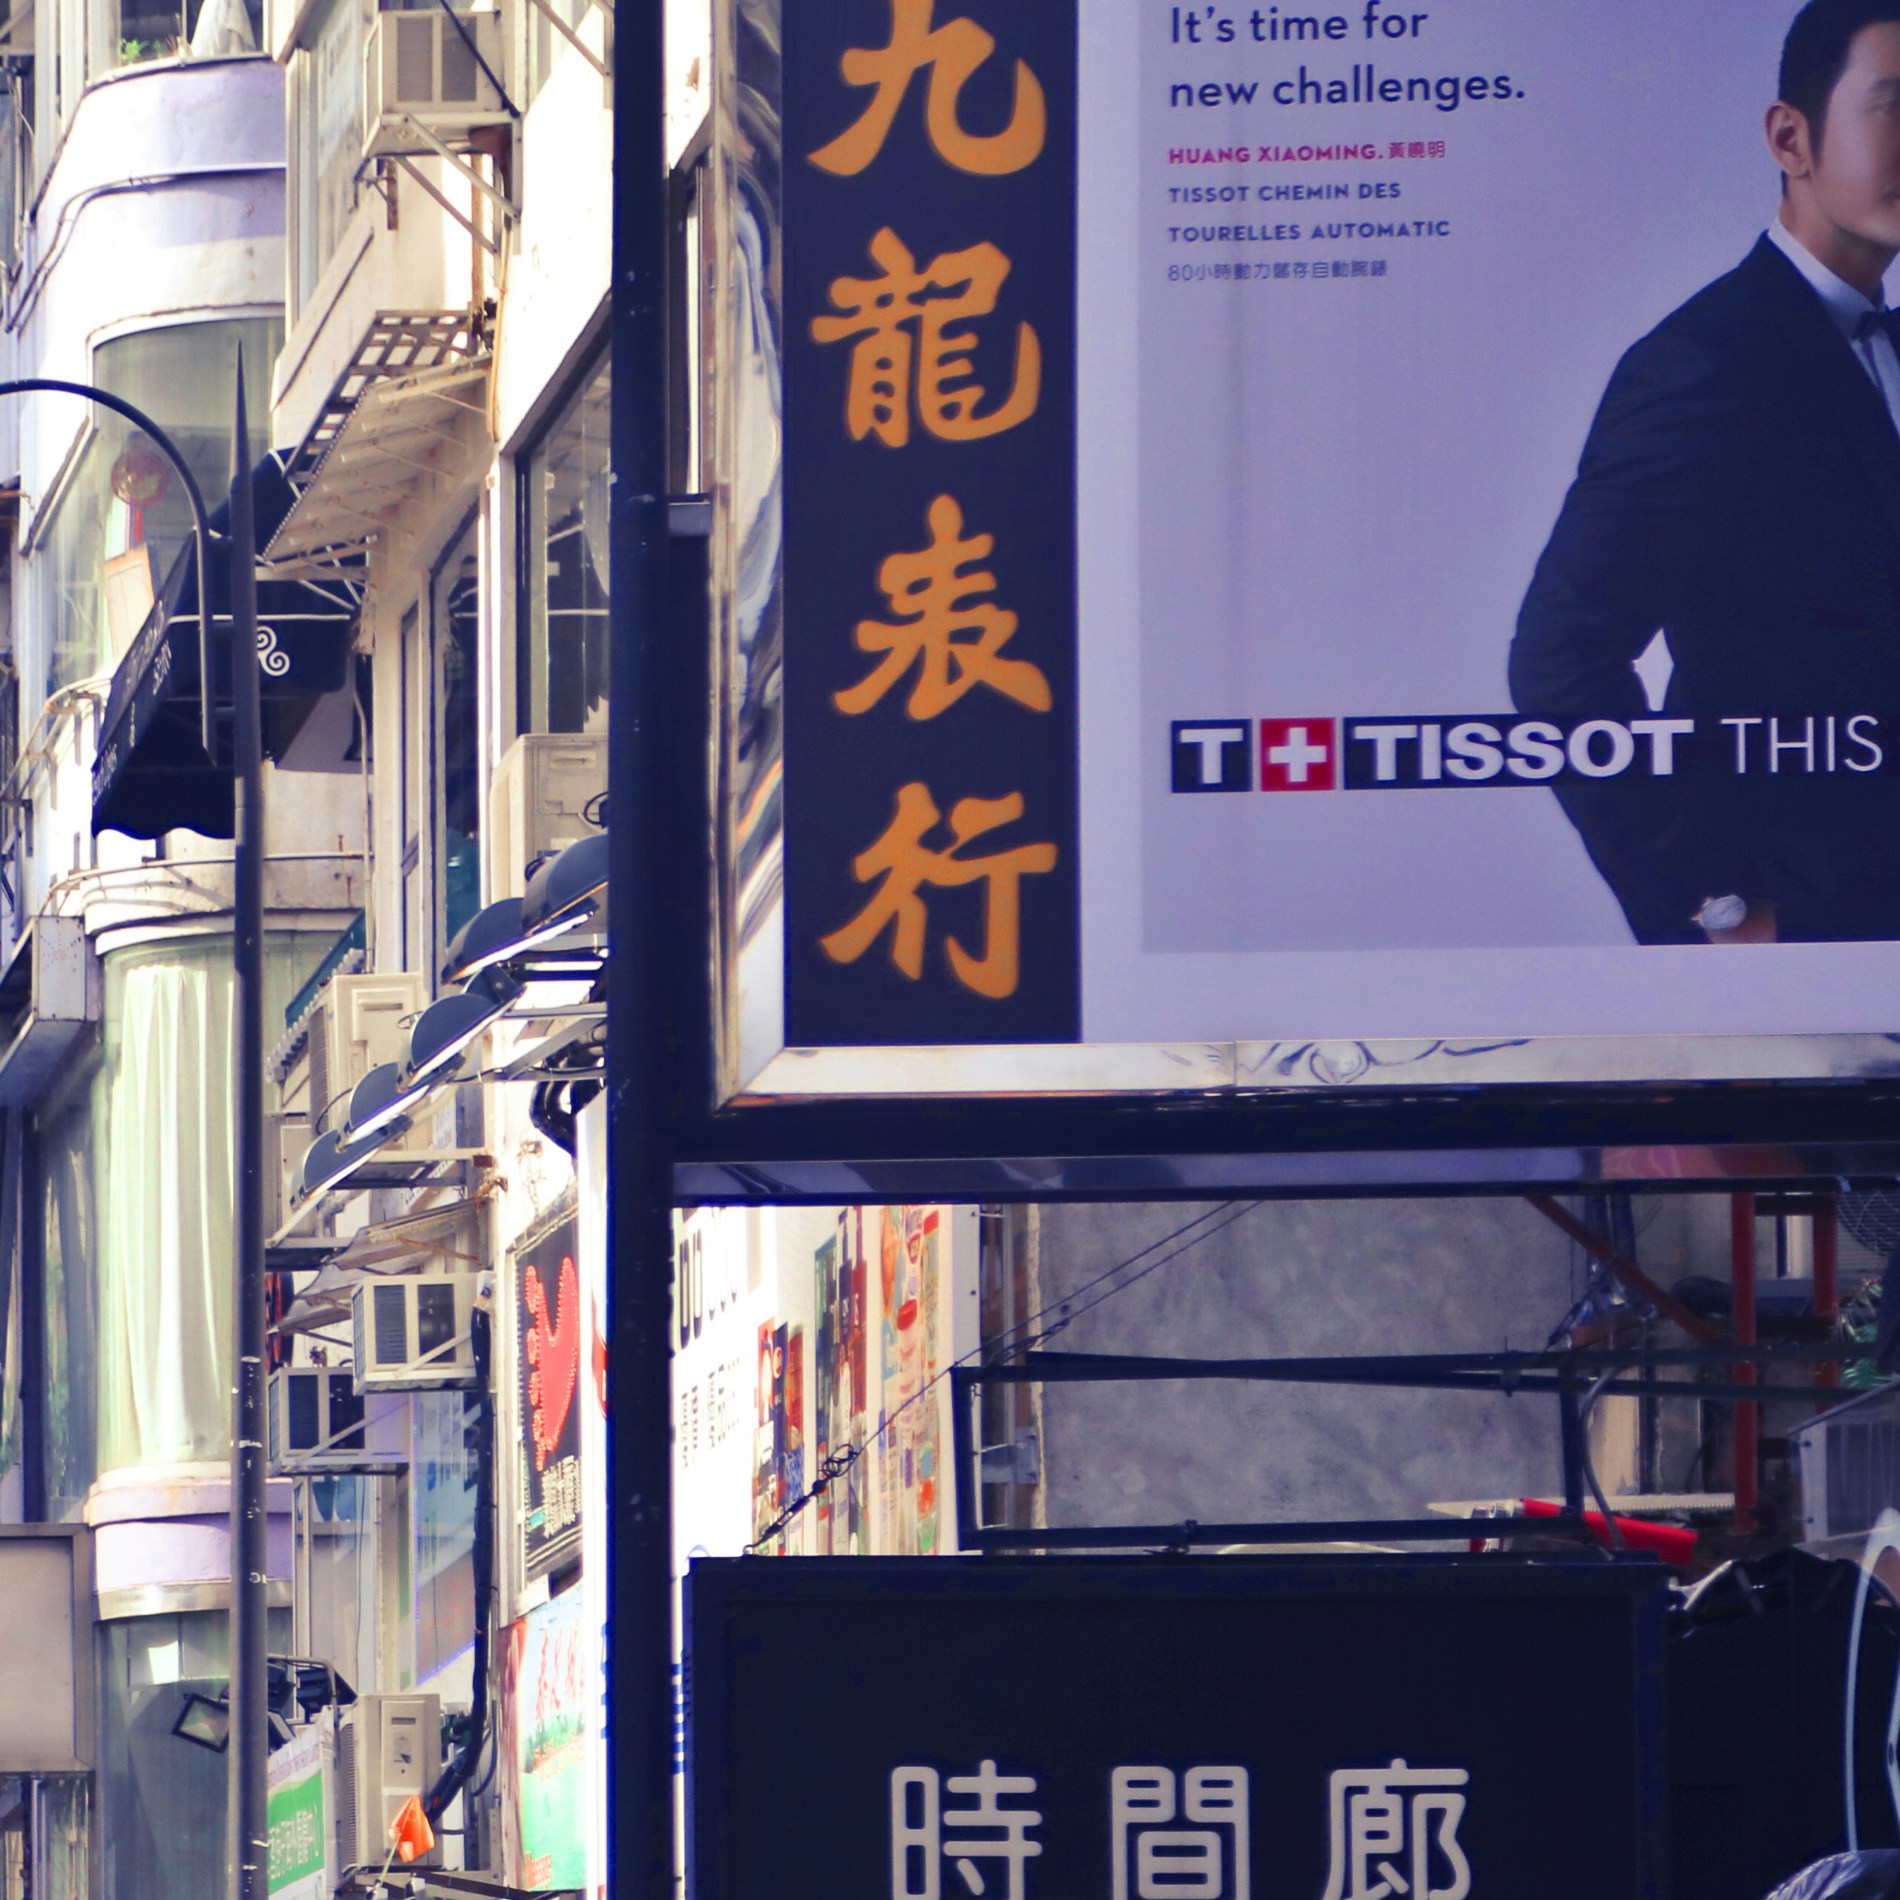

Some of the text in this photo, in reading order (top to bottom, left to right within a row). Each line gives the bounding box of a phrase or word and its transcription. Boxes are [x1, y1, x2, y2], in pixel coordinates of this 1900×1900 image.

[1170, 3, 1428, 45] It's time for
[1169, 65, 1526, 112] new challenges.
[1168, 144, 1251, 164] HUANG
[1258, 142, 1383, 163] XIAOMING.
[1168, 181, 1402, 202] TISSOT CHEMIN DES
[1168, 220, 1452, 243] TOURELLES AUTOMATIC
[1354, 720, 1693, 781] TISSOT
[1720, 716, 1882, 776] THIS
